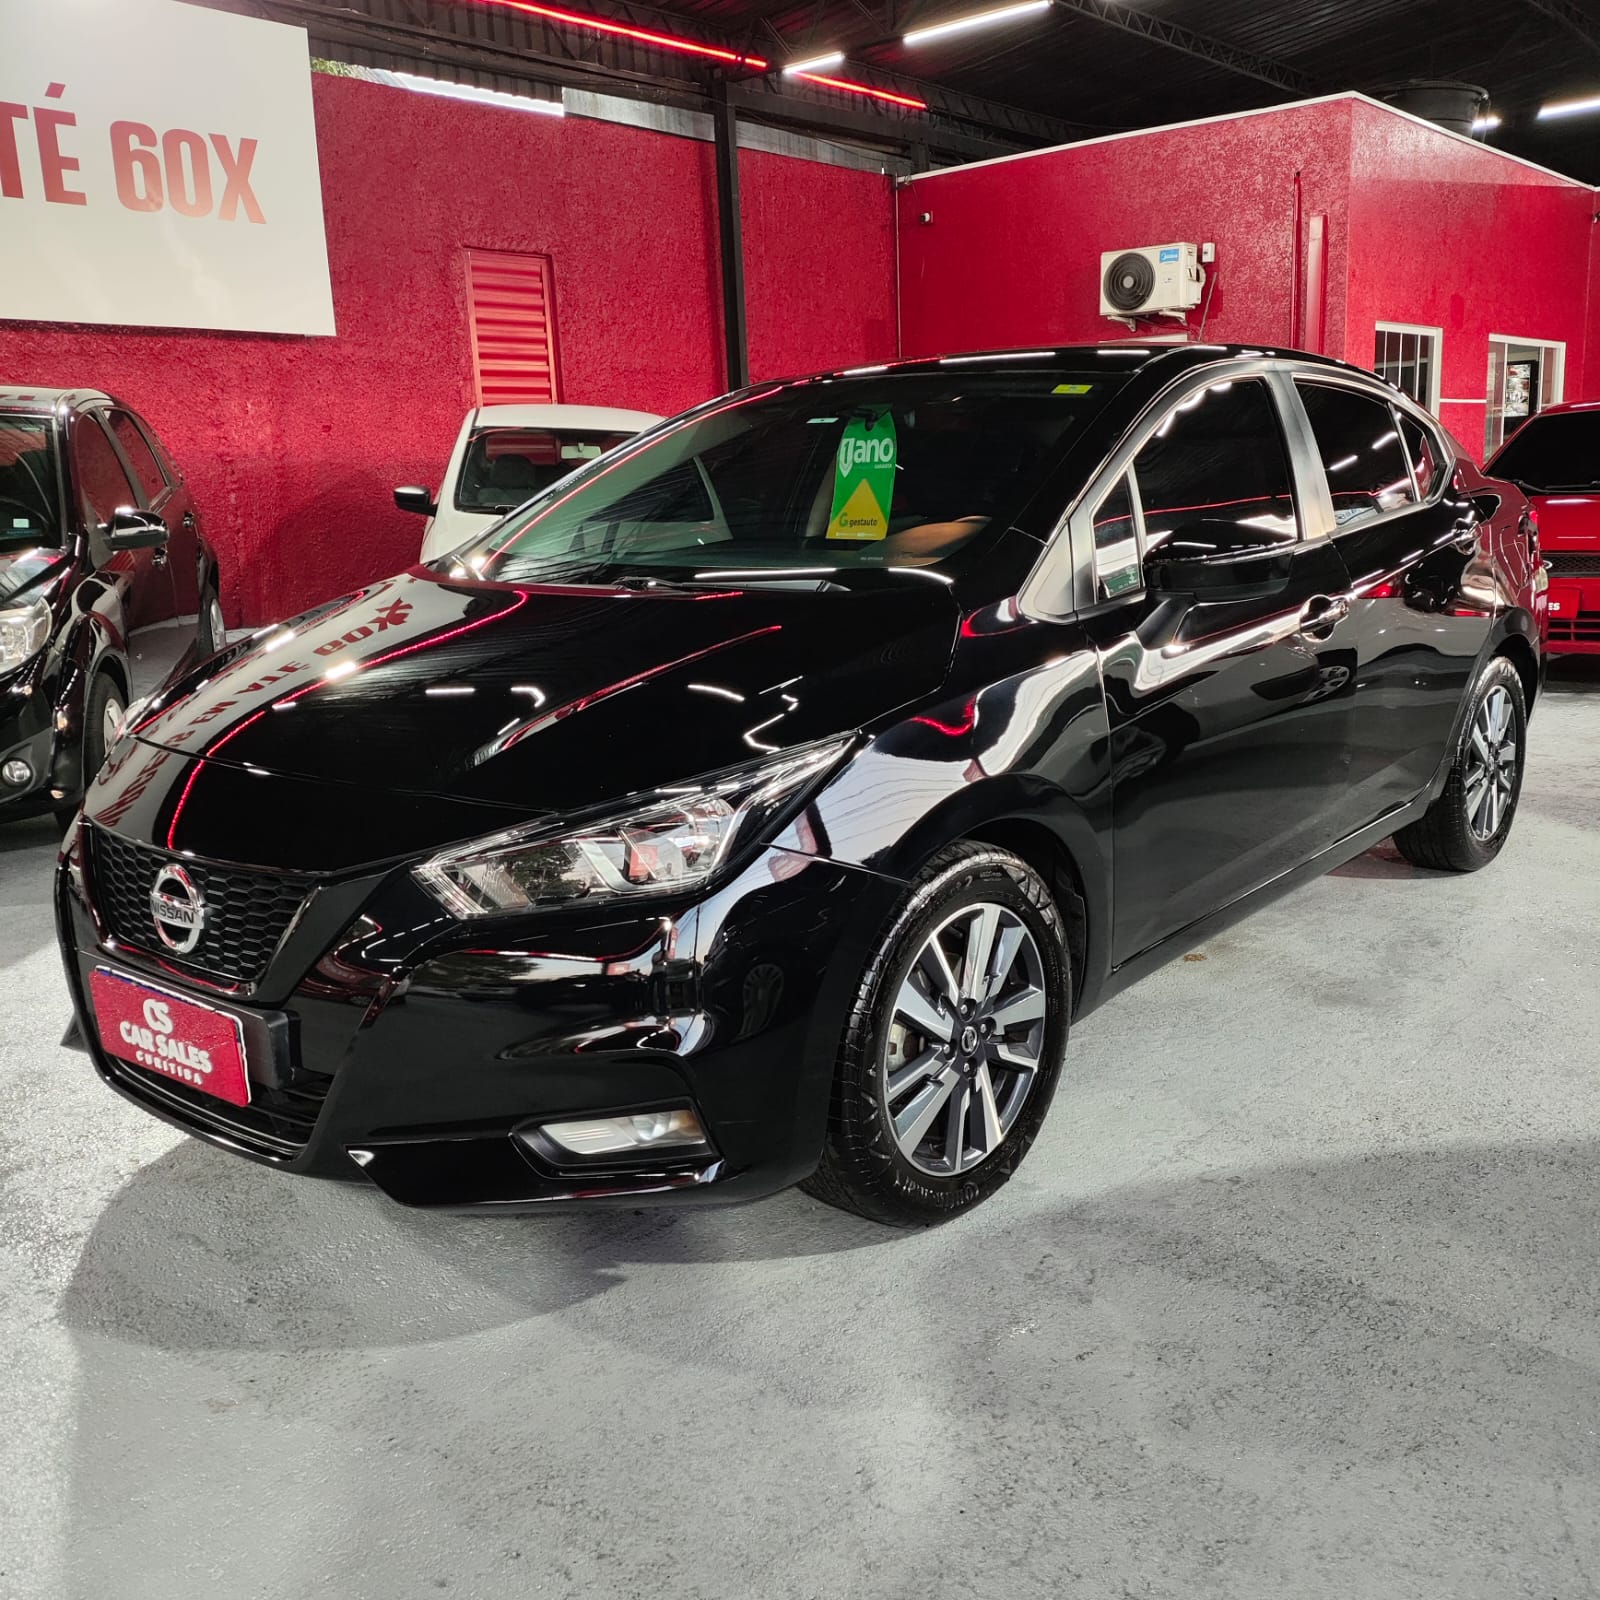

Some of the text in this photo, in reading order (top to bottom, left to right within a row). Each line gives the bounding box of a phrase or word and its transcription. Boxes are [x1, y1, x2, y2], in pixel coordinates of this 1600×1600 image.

[110, 120, 266, 224] 60X
[849, 517, 878, 528] gestauto
[152, 900, 195, 924] NISSAN
[143, 999, 173, 1034] CS
[119, 1021, 212, 1074] CAR SALES
[136, 1050, 203, 1086] CURITIBA
